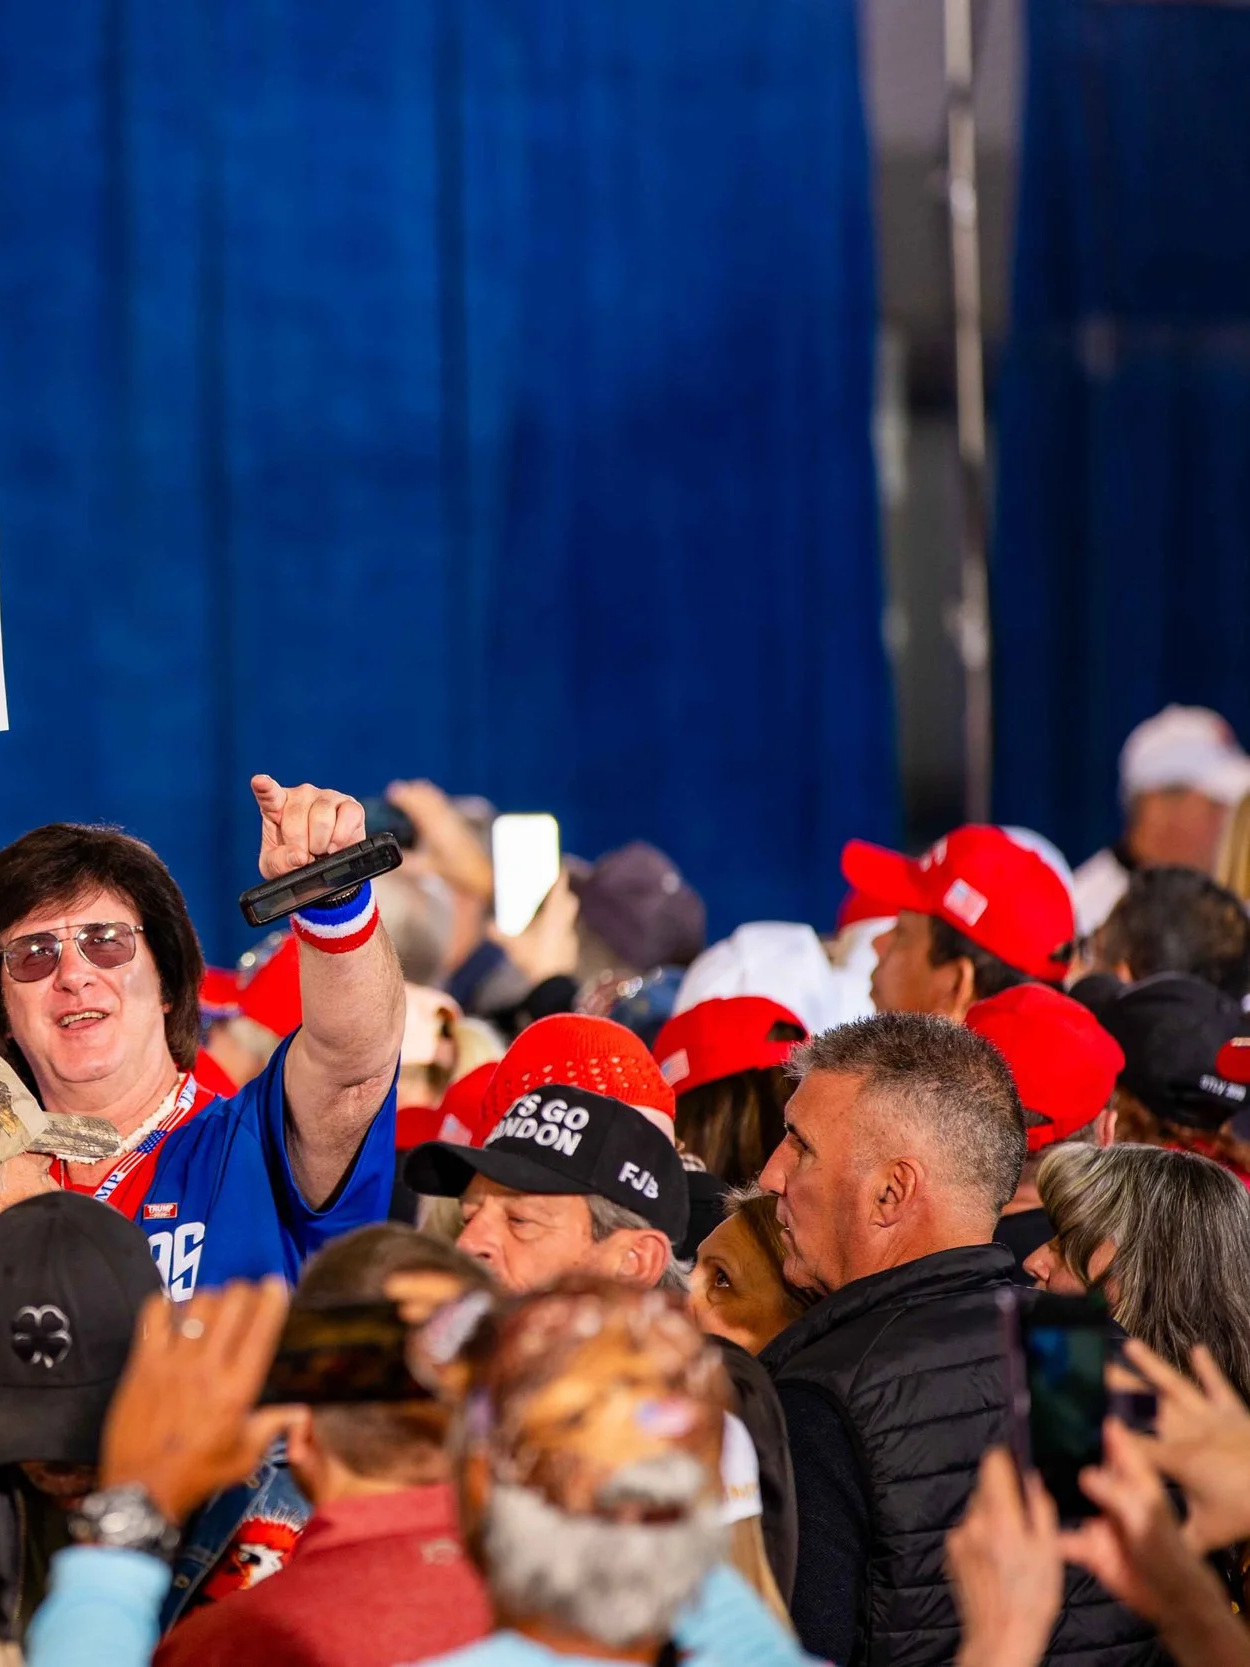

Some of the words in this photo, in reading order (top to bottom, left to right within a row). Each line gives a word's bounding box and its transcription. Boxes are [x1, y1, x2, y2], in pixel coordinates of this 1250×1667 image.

[541, 1099, 590, 1131] GO
[617, 1160, 660, 1199] FJB
[147, 1204, 174, 1214] TRUMP
